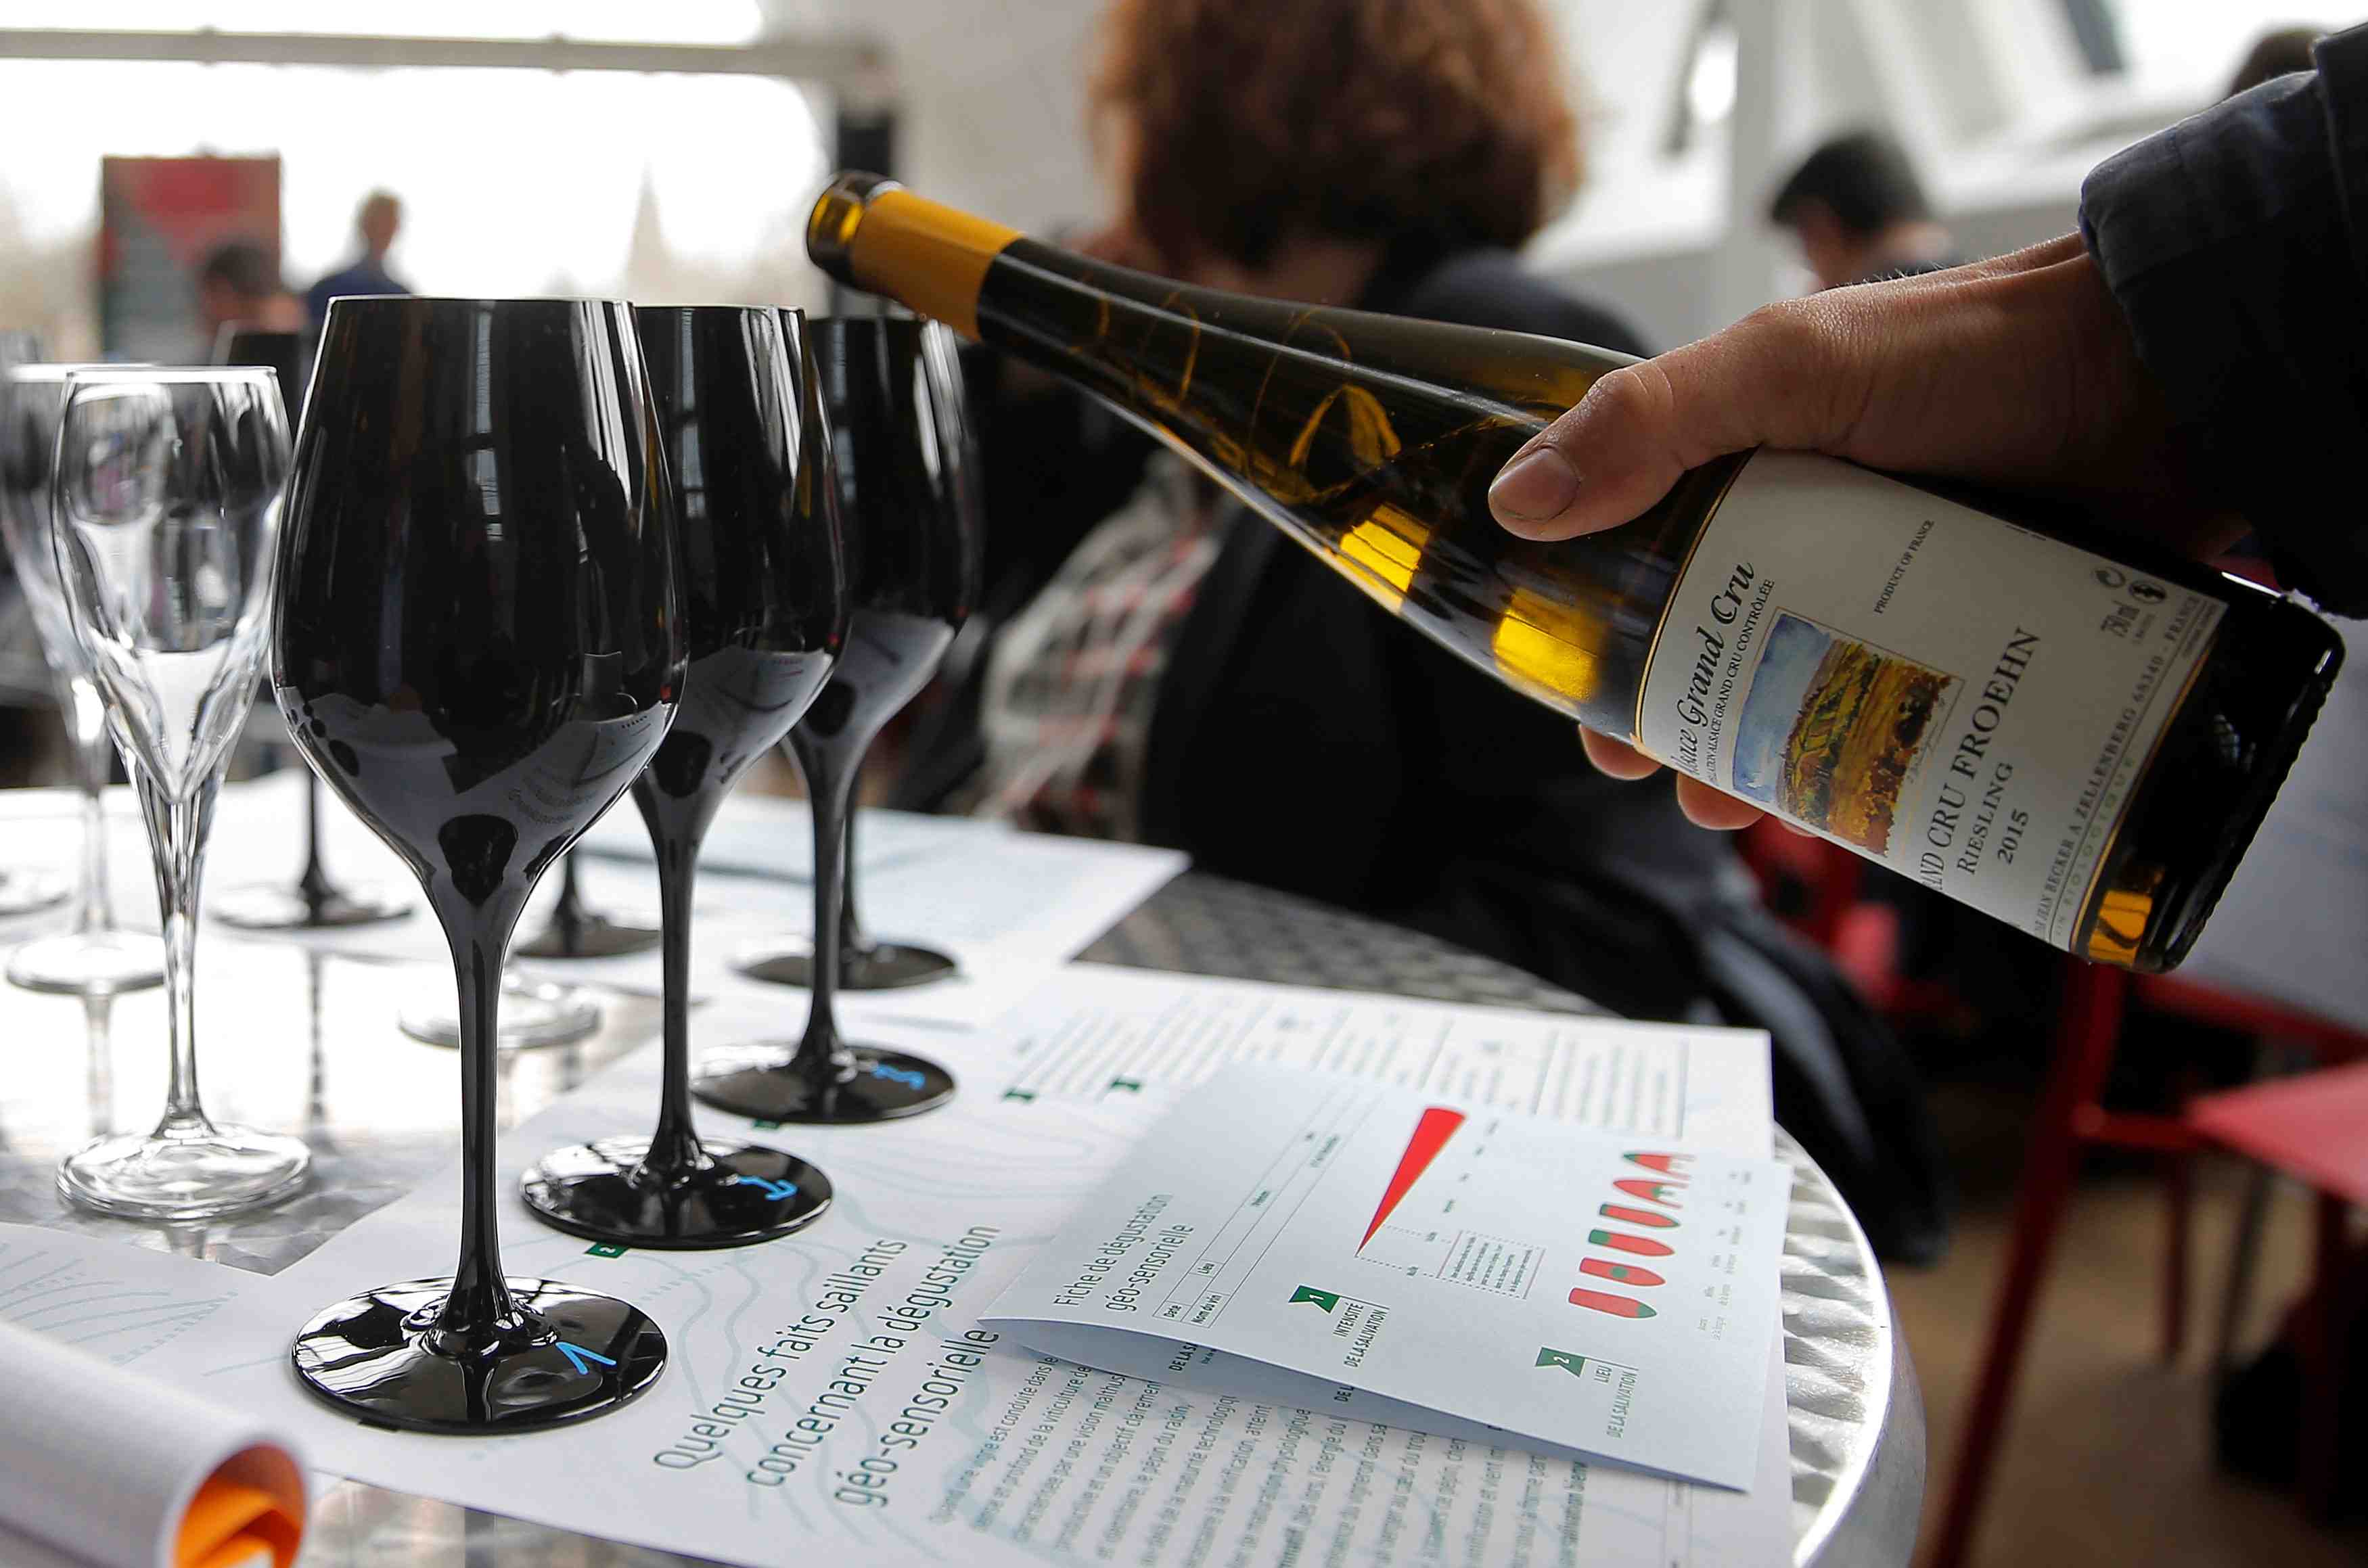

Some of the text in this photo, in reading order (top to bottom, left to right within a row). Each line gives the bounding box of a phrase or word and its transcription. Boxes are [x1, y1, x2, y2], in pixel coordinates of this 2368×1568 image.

[1873, 519, 1935, 614] PRODUCT OF FRANCE
[1736, 579, 1775, 651] CONTRÔLÉE
[1670, 562, 1754, 775] lsace Grand Cru
[1726, 652, 1743, 678] CRU
[1714, 678, 1733, 718] GRAND
[1951, 626, 2041, 781] FROEHN
[1708, 718, 1722, 752] ALSACE
[1928, 783, 1966, 848] CRU
[1957, 762, 2013, 875] RIESLING
[2045, 839, 2075, 894] BECKER
[2073, 708, 2137, 820] ZELLENBERG
[1997, 808, 2030, 864] 2015
[1920, 852, 1944, 891] AND
[1053, 1194, 1173, 1306] Fiche de dégustation
[1105, 1224, 1195, 1312] géo-sensorielle
[1163, 1262, 1215, 1318] Date Lieu
[1191, 1294, 1222, 1324] Nom du vin
[1332, 1301, 1364, 1337] INTENSITÉ
[1344, 1309, 1388, 1368] DE LA SALIVATION
[654, 1237, 909, 1470] Quelques faits saillants
[746, 1224, 1001, 1488] concernant la dégustation
[1024, 1366, 1053, 1387] dans
[1037, 1356, 1060, 1370] le
[1168, 1358, 1185, 1372] DE
[1175, 1351, 1192, 1364] LA
[1594, 1365, 1613, 1383] LIEU
[834, 1327, 1000, 1508] géo-sensorielle
[1001, 1385, 1039, 1427] conduite
[1032, 1421, 1054, 1433] la
[1043, 1385, 1079, 1425] viticulture
[1073, 1365, 1093, 1386] de
[1074, 1410, 1101, 1440] vision
[1093, 1374, 1126, 1411] malthus
[1163, 1403, 1196, 1431] raisin,
[1245, 1404, 1273, 1437] atteint
[1334, 1389, 1352, 1403] DE
[1606, 1370, 1637, 1439] DE LA SALIVATION
[990, 1426, 1011, 1443] est
[1101, 1427, 1135, 1464] objectif
[1152, 1433, 1176, 1446] du
